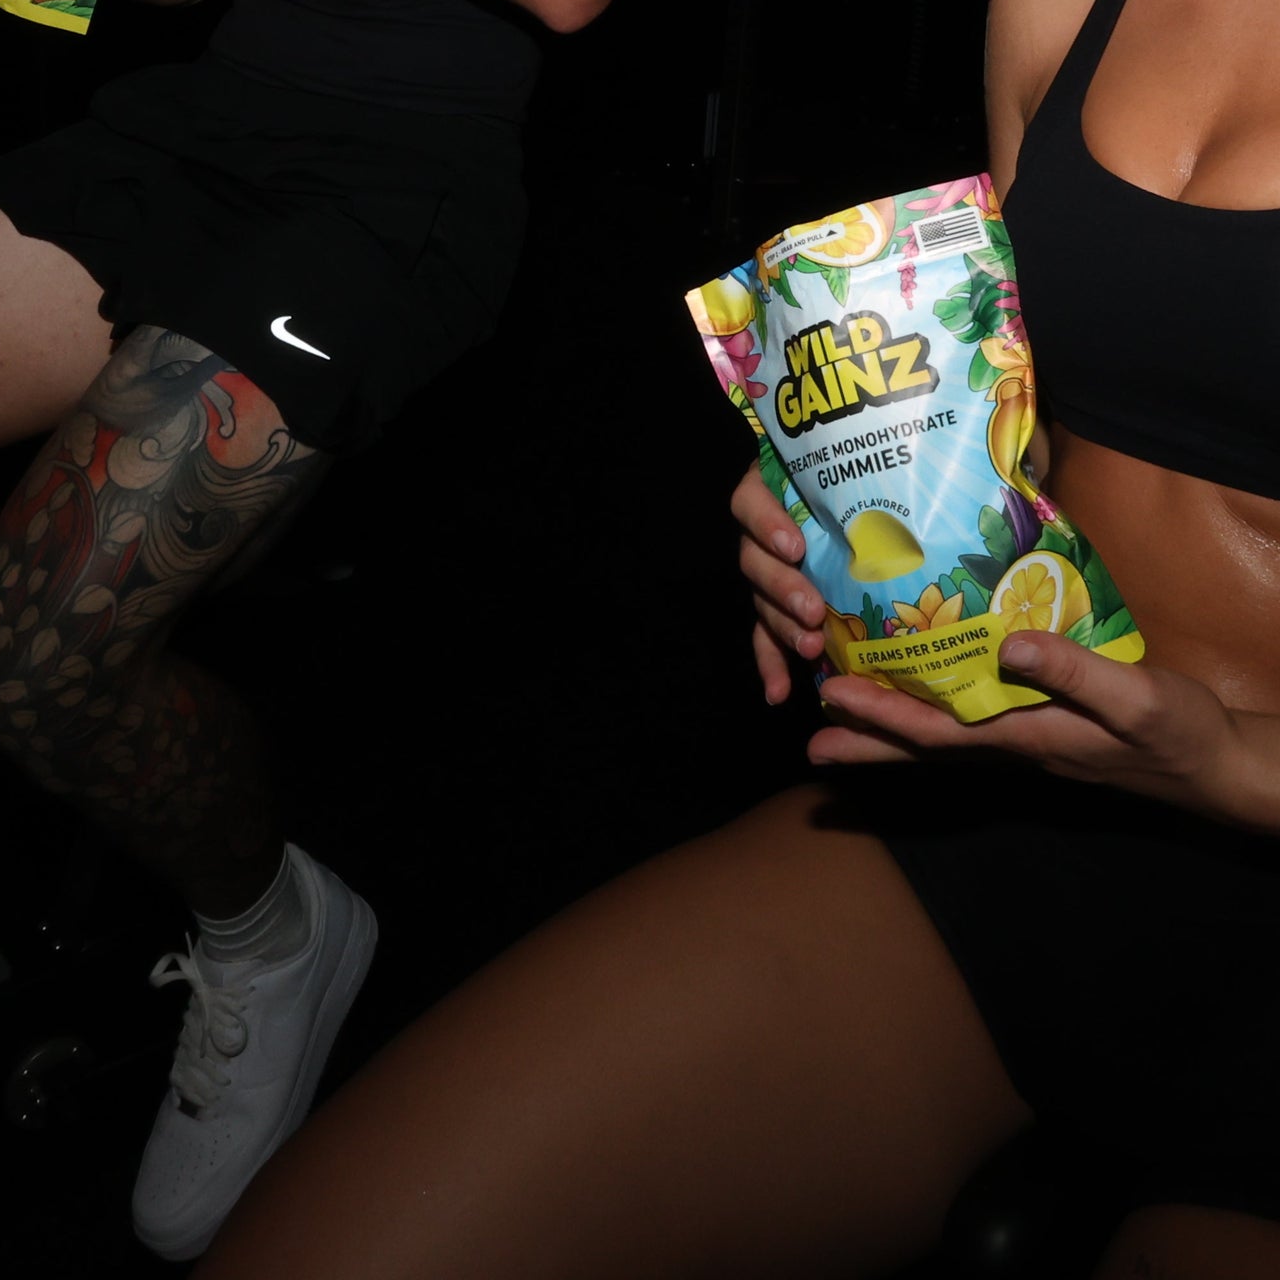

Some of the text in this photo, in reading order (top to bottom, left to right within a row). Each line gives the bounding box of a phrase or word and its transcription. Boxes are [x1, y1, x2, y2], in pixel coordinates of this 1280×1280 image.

[793, 238, 806, 249] AND
[807, 234, 824, 243] PULL
[785, 315, 884, 377] WILD
[776, 337, 933, 429] GAINZ
[787, 409, 958, 477] CREATINE MONOHYDRATE
[817, 444, 913, 490] GUMMIES
[839, 497, 911, 529] MON FLAVORED
[858, 626, 990, 665] 5 GRAMS PER SERVING
[924, 661, 942, 672] 150
[943, 645, 989, 668] GUMMIES
